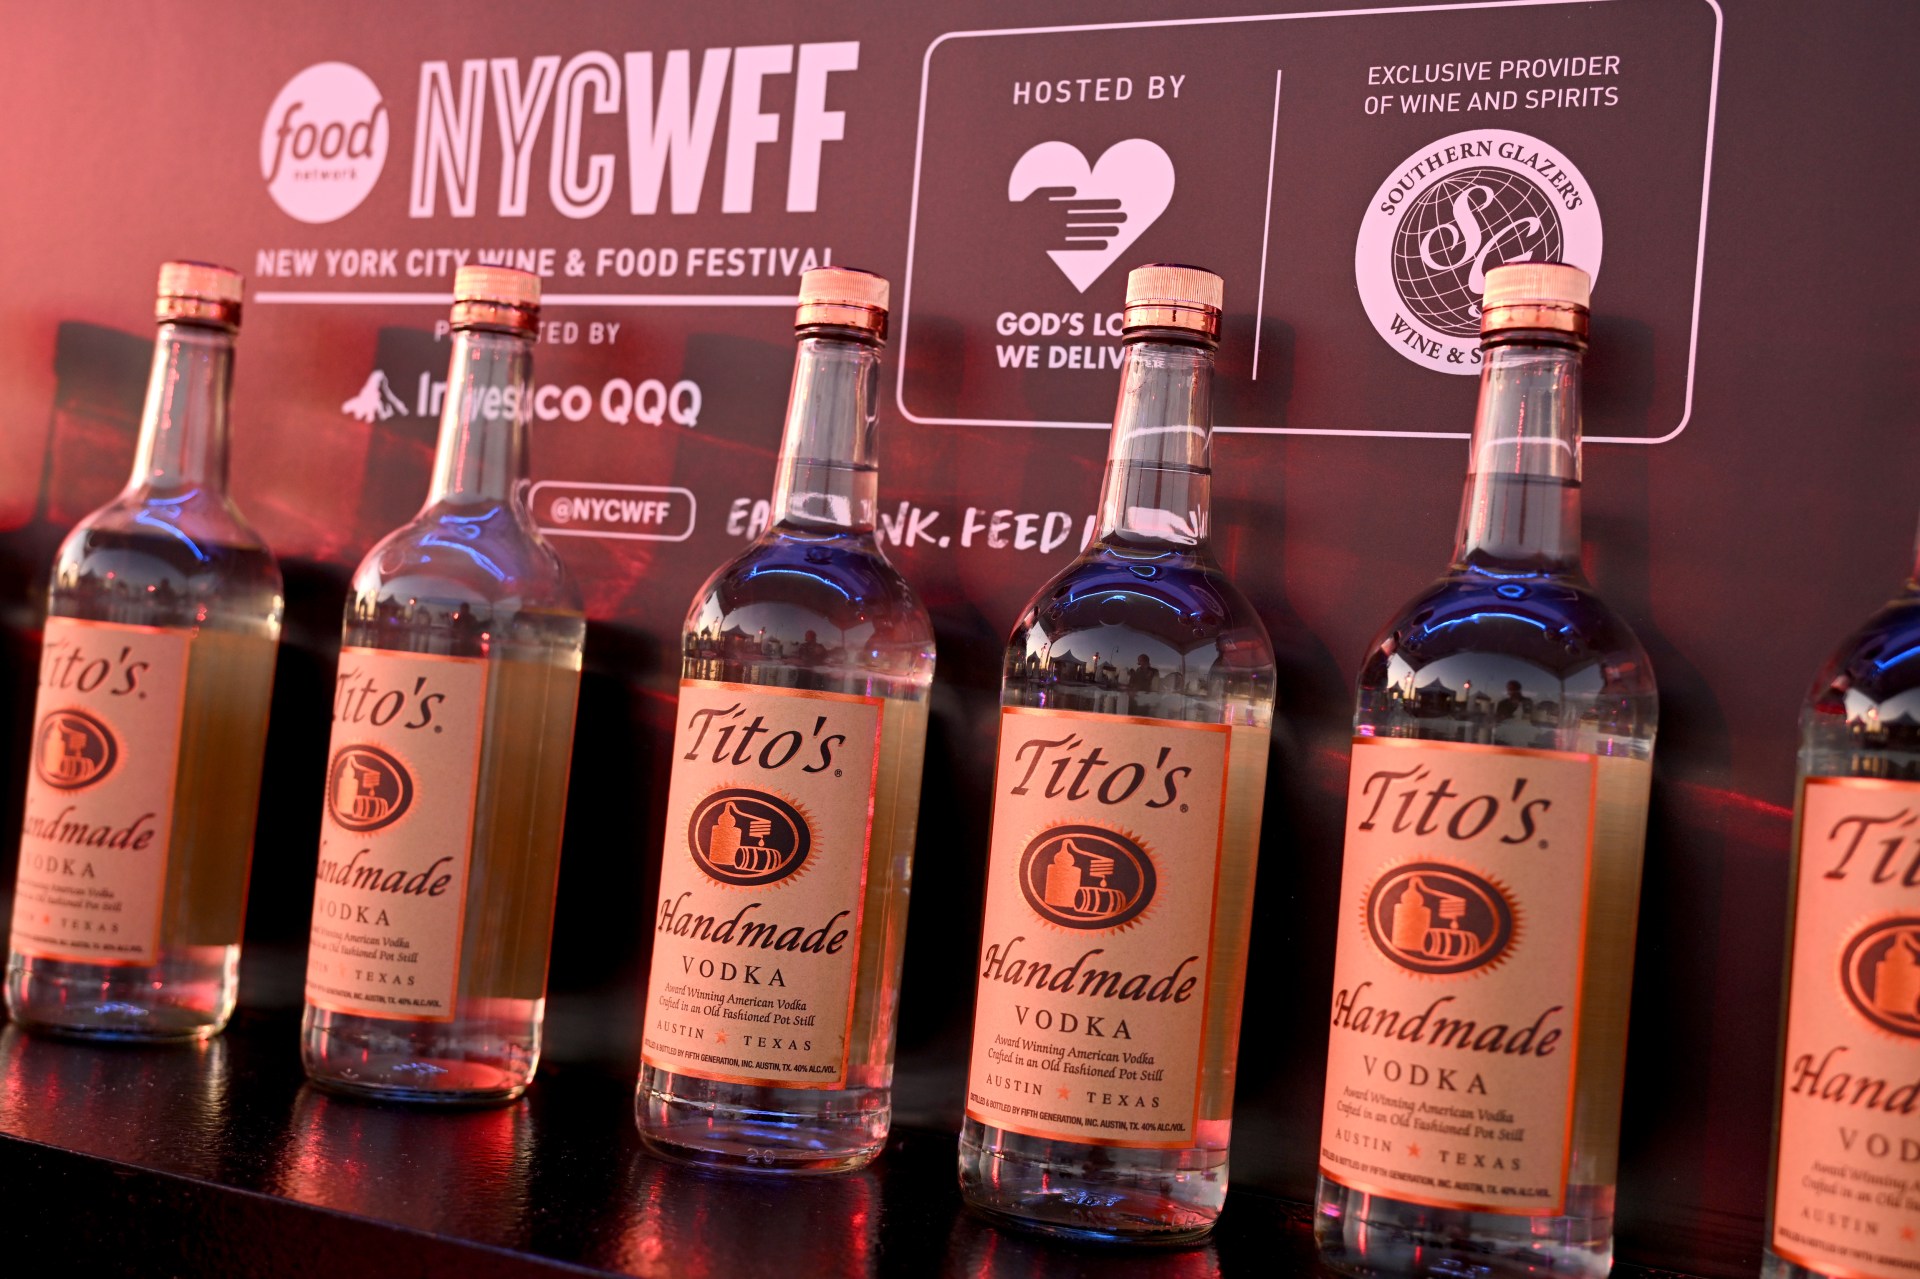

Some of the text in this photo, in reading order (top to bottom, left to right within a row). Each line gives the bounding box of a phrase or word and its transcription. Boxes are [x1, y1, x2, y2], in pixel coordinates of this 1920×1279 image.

[1368, 55, 1620, 85] EXCLUSIVE PROVIDER
[1012, 75, 1186, 105] HOSTED BY
[1364, 87, 1619, 115] OF WINE AND SPIRITS
[267, 101, 388, 184] food
[409, 41, 860, 219] NYCWFF
[1380, 140, 1583, 216] SOUTHERN GLAZER'S
[256, 249, 318, 277] NEW
[324, 249, 398, 277] YORK
[406, 248, 470, 277] CITY
[477, 248, 556, 277] WINE
[564, 248, 586, 277] &
[596, 248, 679, 277] FOOD
[588, 321, 621, 345] BY
[996, 312, 1125, 336] GOD'S LO
[1390, 313, 1443, 360] WINE
[1446, 347, 1465, 364] &
[996, 345, 1126, 369] WE DELIV
[600, 378, 702, 428] QQQ
[550, 497, 671, 525] @NYCWFF
[961, 507, 1073, 554] FEED
[683, 702, 846, 773] Tito's
[1010, 732, 1192, 808] Tito's
[1358, 763, 1551, 844] Tito's
[657, 891, 850, 955] Handmade
[355, 969, 415, 986] TEXAS
[682, 955, 787, 988] VODKA
[982, 936, 1199, 1004] Handmade
[681, 1001, 689, 1011] in
[690, 1005, 701, 1014] an
[703, 1005, 721, 1017] Old
[722, 1008, 771, 1024] Fashioned
[773, 1014, 791, 1026] Pot
[793, 1014, 816, 1027] Still
[687, 987, 725, 1006] Winning
[726, 994, 774, 1009] American
[777, 999, 807, 1012] Vodka
[657, 1019, 812, 1051] AUSTIN TEXAS
[1015, 1005, 1132, 1040] VODKA
[1333, 981, 1563, 1057] Handmade
[677, 1049, 685, 1057] BY
[684, 1050, 700, 1060] FIFTH
[700, 1054, 740, 1068] GENERATION,
[741, 1060, 754, 1069] INC.
[755, 1061, 781, 1072] AUSTIN,
[793, 1064, 808, 1073] 40%
[988, 1048, 1164, 1082] Crafted in an Old Fashioned Pot Still
[994, 1034, 1155, 1065] Award Winning American Vodka
[986, 1074, 1160, 1108] AUSTIN TEXAS
[1363, 1055, 1487, 1095] VODKA
[990, 1100, 1011, 1113] BOTTLED
[1012, 1106, 1020, 1115] BY
[1021, 1108, 1038, 1118] FIFTH
[1039, 1112, 1084, 1127] GENERATION,
[1084, 1117, 1099, 1128] INC.
[1100, 1119, 1128, 1131] AUSTIN,
[1141, 1122, 1156, 1131] 40%
[1371, 1091, 1415, 1112] Winning
[1417, 1102, 1474, 1120] American
[1478, 1108, 1514, 1123] Vodka
[1390, 1113, 1410, 1127] Old
[1413, 1119, 1470, 1137] Fashioned
[1474, 1127, 1494, 1140] Pot
[1498, 1127, 1524, 1142] Still
[1336, 1128, 1521, 1171] AUSTIN TEXAS
